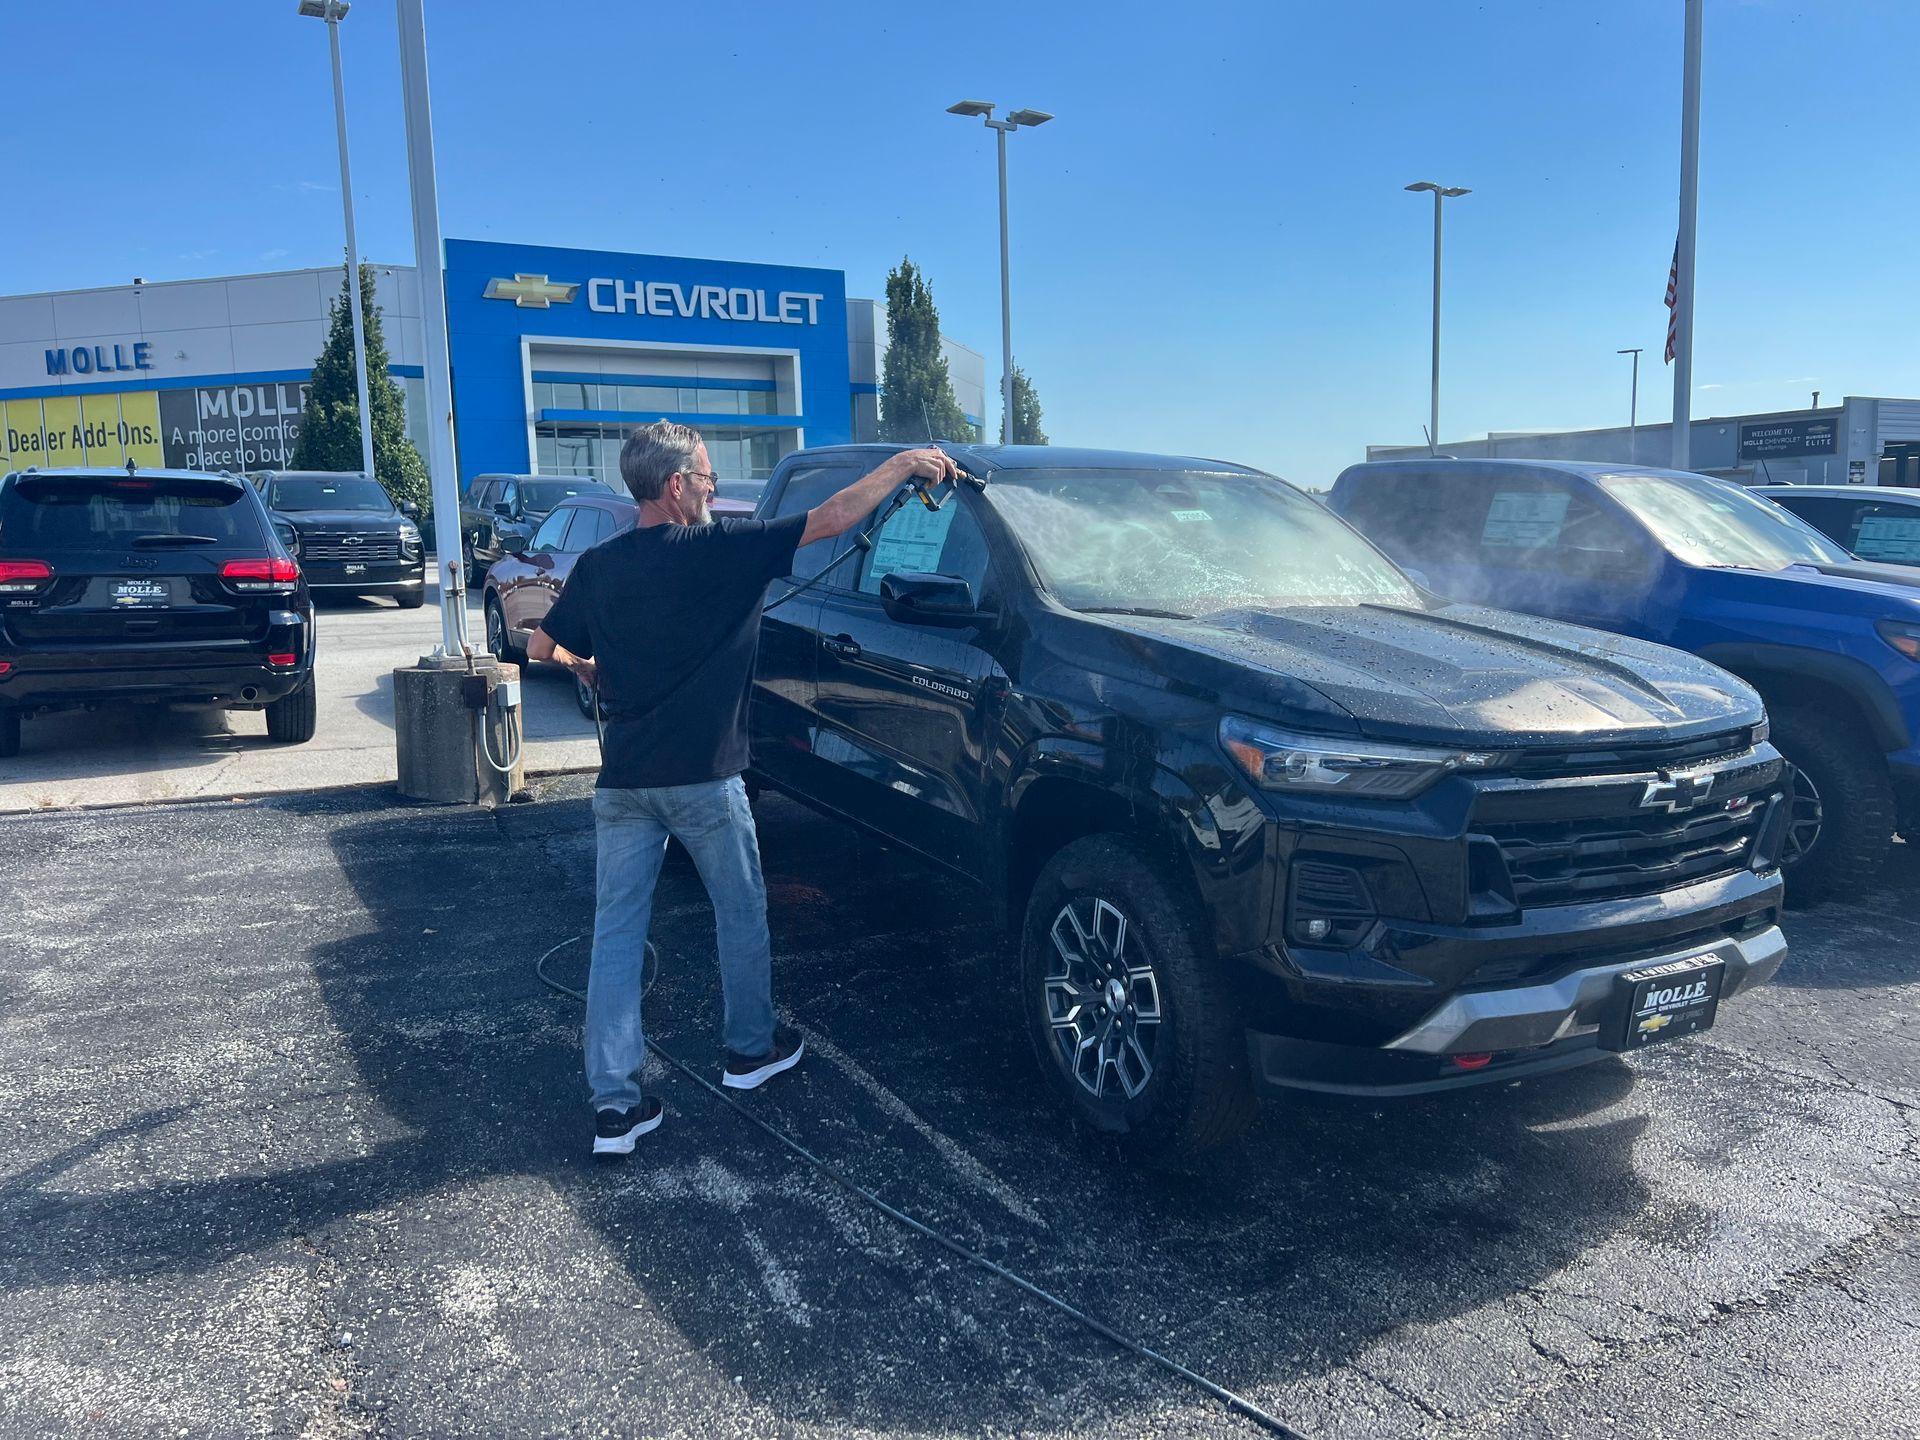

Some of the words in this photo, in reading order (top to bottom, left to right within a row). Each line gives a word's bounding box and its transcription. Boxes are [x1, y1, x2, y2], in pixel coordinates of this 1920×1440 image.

[588, 277, 823, 325] CHEVROLET
[45, 342, 153, 376] MOLLE
[8, 424, 66, 453] Dealer
[72, 421, 158, 449] Add-Ons.
[171, 427, 185, 446] A
[189, 428, 236, 444] more
[1751, 428, 1782, 438] WELCOME
[1783, 427, 1793, 435] TO
[1764, 436, 1801, 445] CHEVROLET
[1805, 438, 1832, 447] ELITE
[186, 447, 232, 470] place
[235, 447, 256, 464] to
[260, 443, 295, 467] buy
[117, 586, 162, 594] MOLLE
[912, 675, 969, 699] COLORADO
[1643, 981, 1707, 1009] MOLLE
[1658, 1000, 1689, 1012] CHEVROLET
